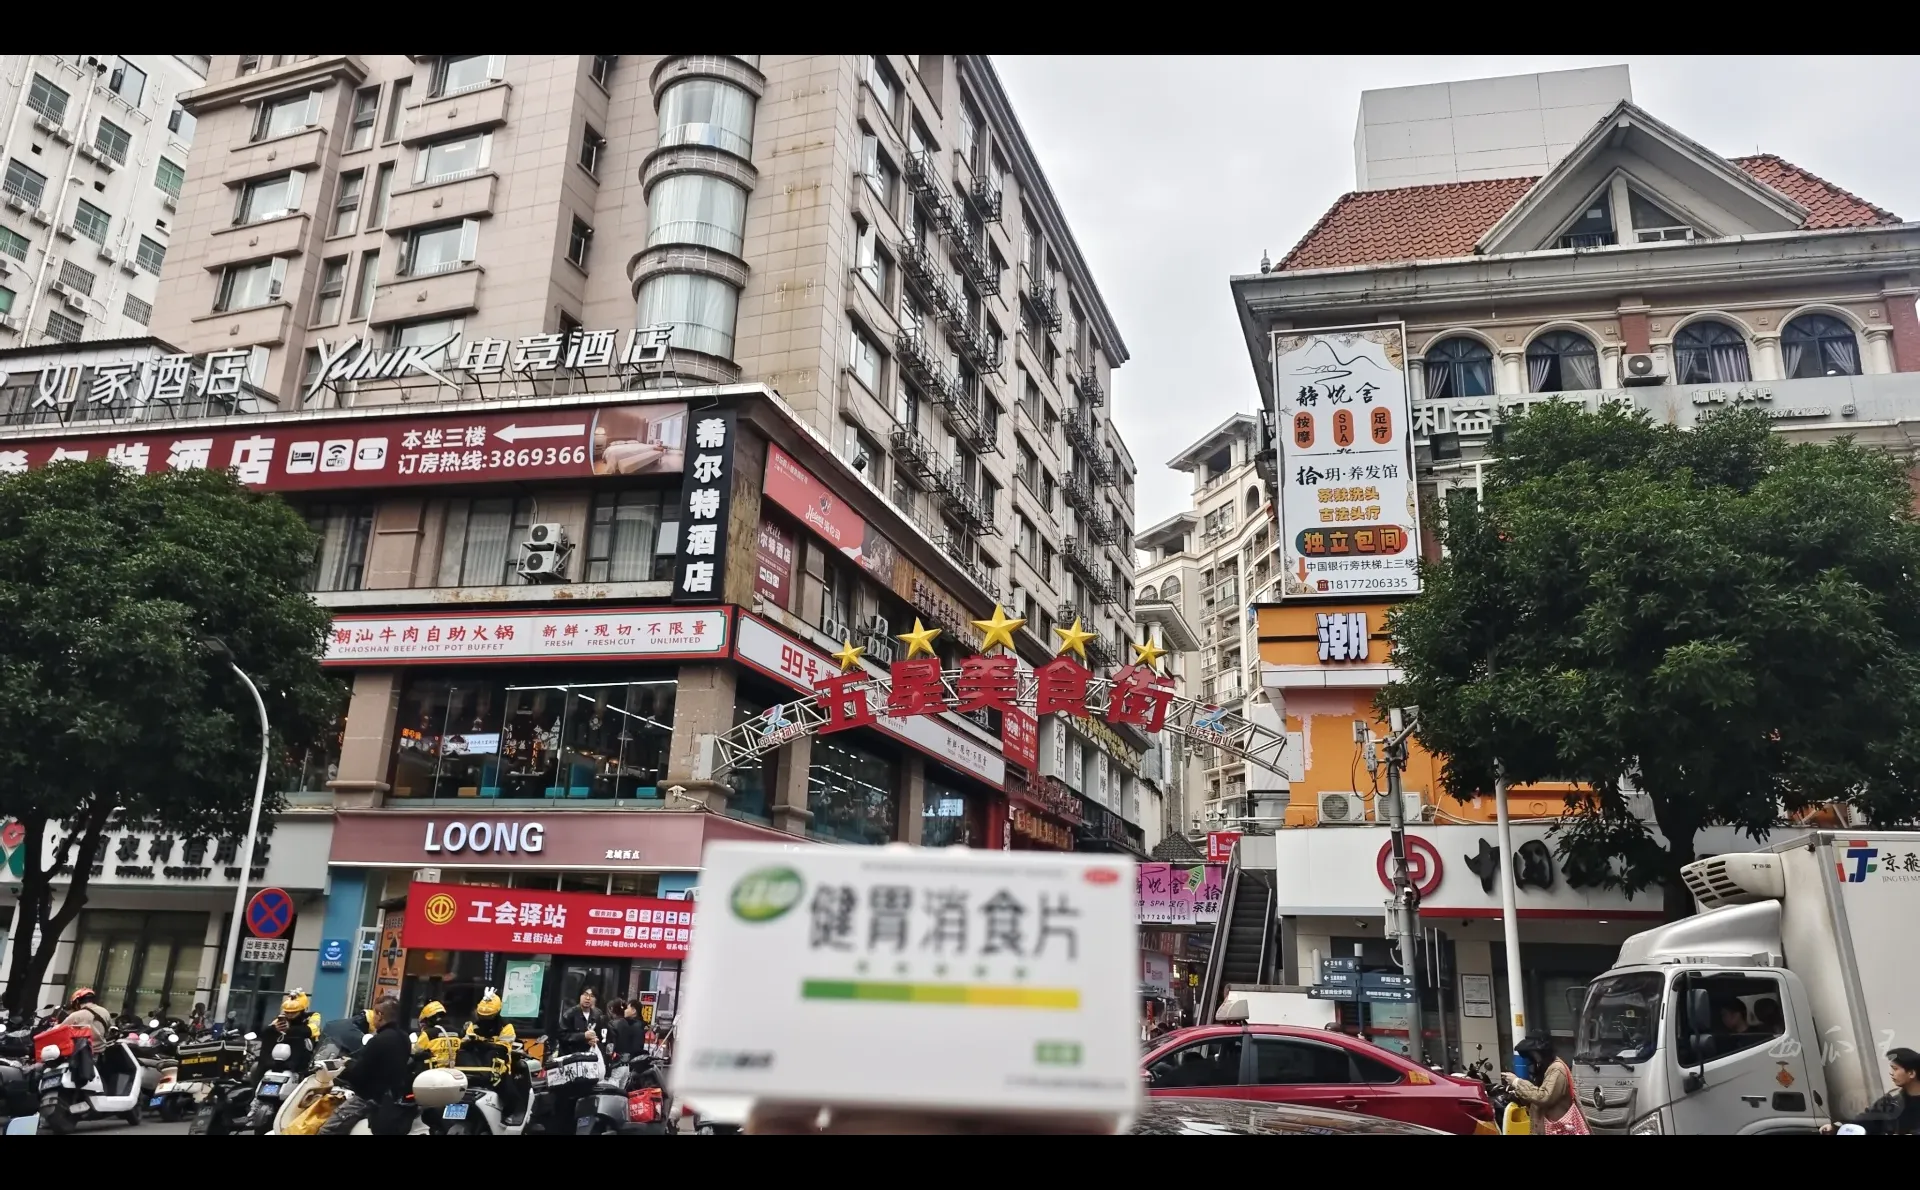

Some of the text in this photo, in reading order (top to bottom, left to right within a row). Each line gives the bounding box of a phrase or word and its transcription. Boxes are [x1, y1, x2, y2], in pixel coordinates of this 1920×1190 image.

[458, 325, 675, 375] 电竞酒店
[31, 348, 250, 409] 如家酒店
[401, 424, 487, 450] 本坐三楼
[1296, 416, 1311, 443] 按摩
[1338, 413, 1349, 443] SPA
[1373, 412, 1388, 438] 足疗
[398, 444, 587, 475] 订房热线:3869366
[682, 418, 727, 593] 希尔特酒店
[1319, 506, 1380, 522] 古法头疗
[757, 531, 792, 565] 尔特酒店
[1304, 529, 1401, 554] 独立包间
[1306, 559, 1416, 572] 中国银行旁扶梯上三楼
[1331, 578, 1408, 590] 18177206335
[333, 624, 515, 644] 潮汕牛肉自助火锅
[467, 643, 504, 651] BUFFET
[1316, 612, 1368, 660] 潮
[781, 644, 818, 684] 99号
[813, 654, 1174, 734] 五星美食街
[1056, 723, 1064, 769] 采耳
[424, 822, 545, 853] LOONG
[605, 849, 640, 860] 龙城西点
[467, 901, 566, 928] 工会驿站
[808, 884, 1086, 961] 健胃消食片
[512, 932, 563, 944] 五星街站点
